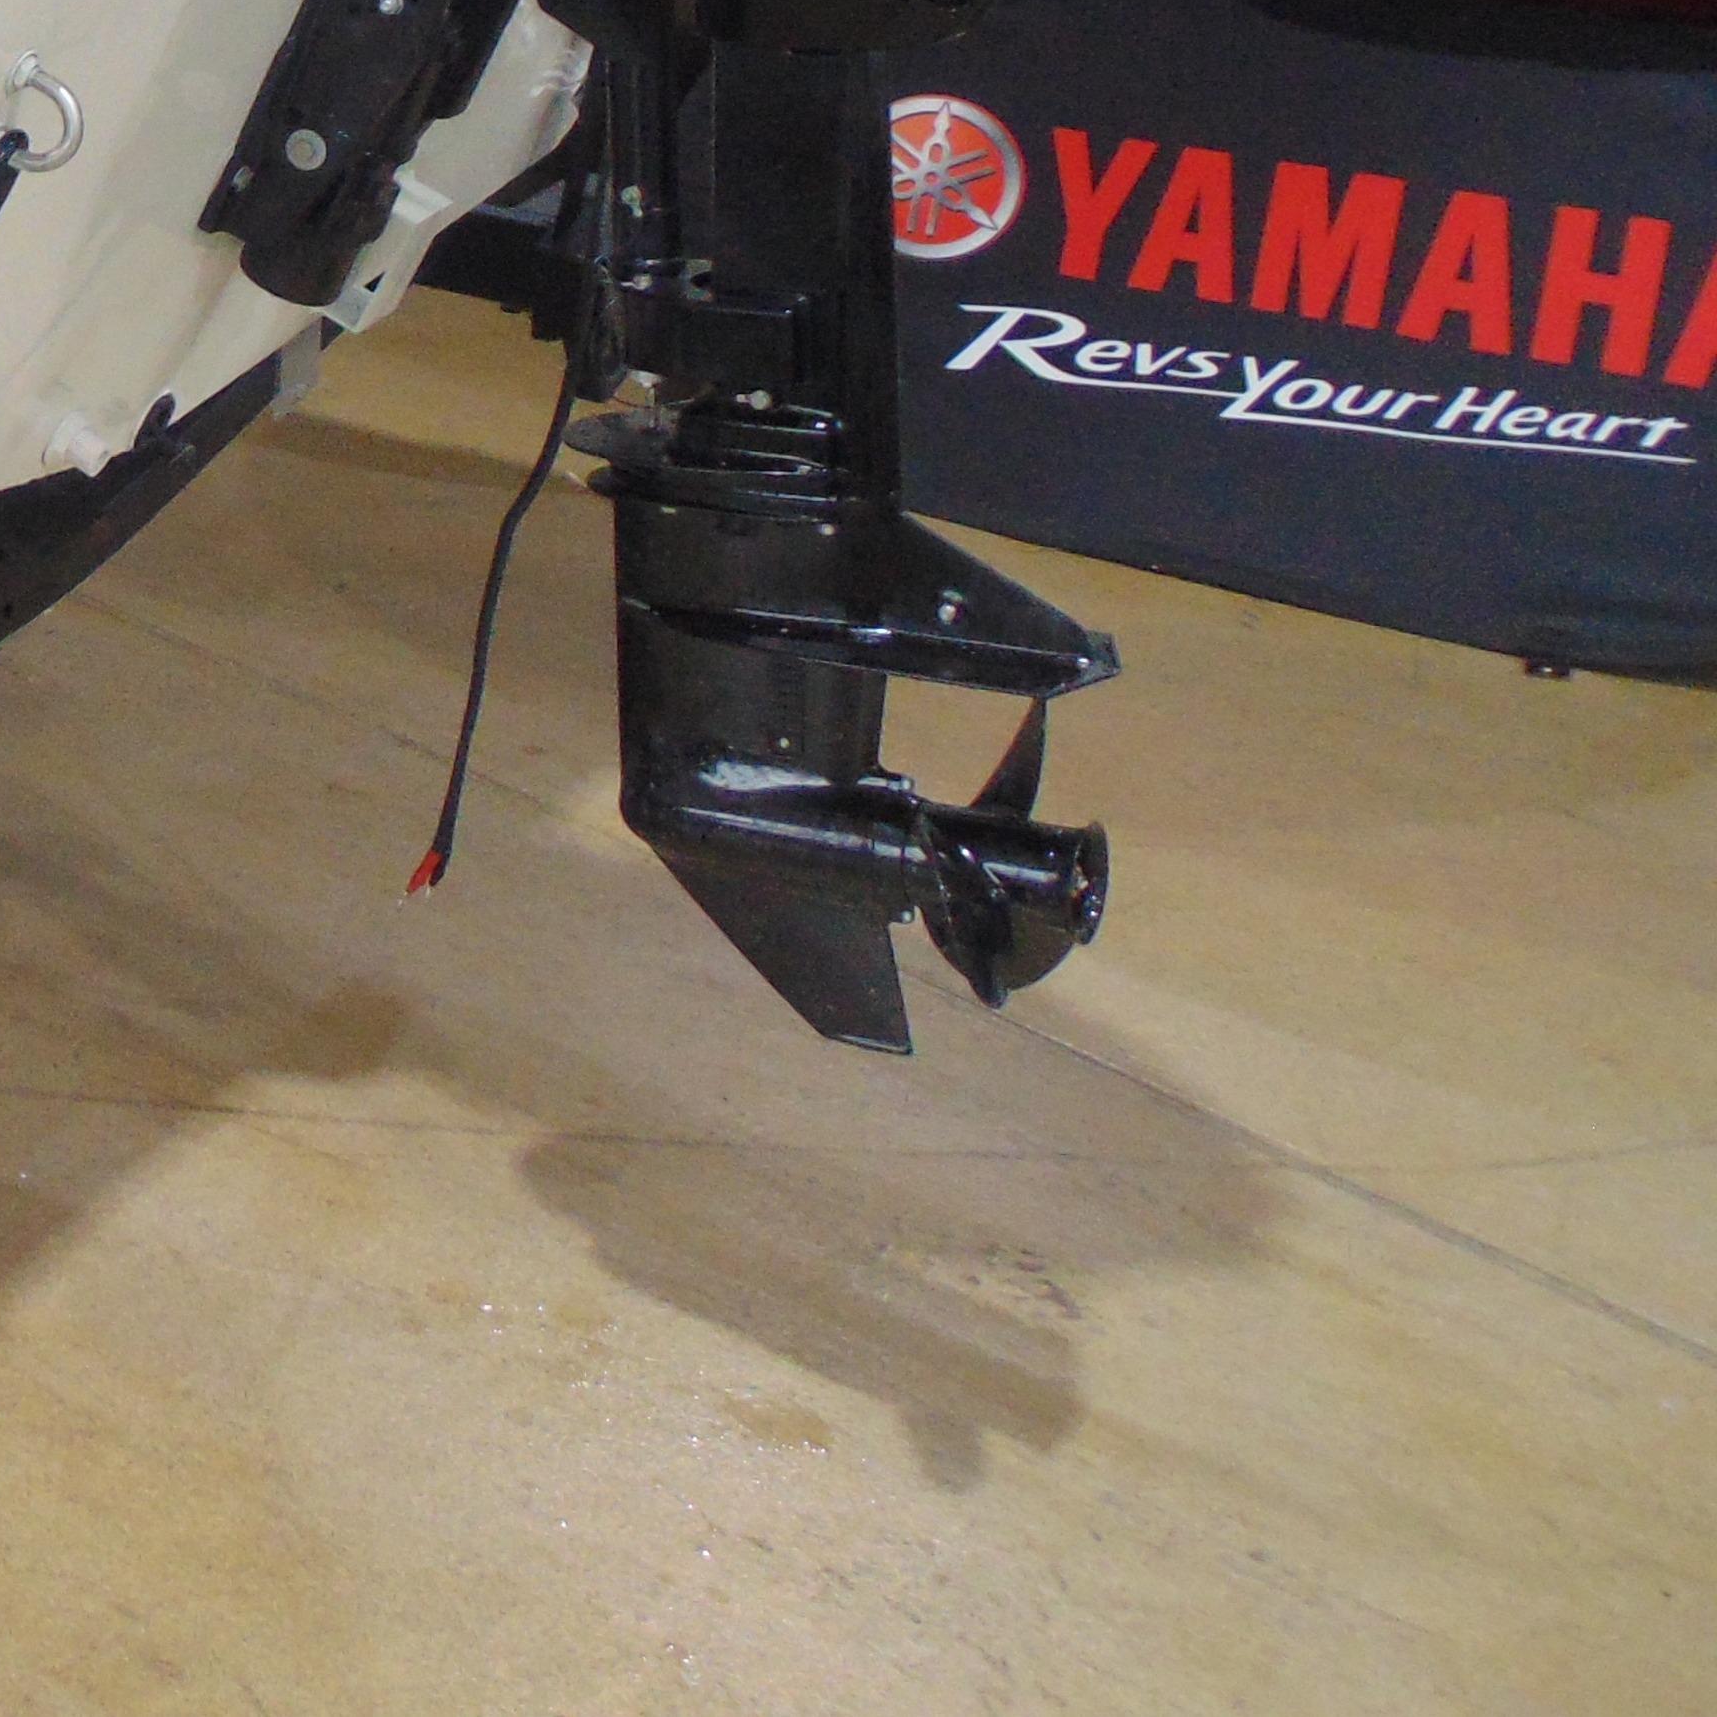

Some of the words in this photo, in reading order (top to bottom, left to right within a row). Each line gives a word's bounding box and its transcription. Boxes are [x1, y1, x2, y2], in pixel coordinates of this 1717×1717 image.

[945, 304, 1237, 394] Revs
[1220, 356, 1442, 422] Your
[1434, 386, 1691, 450] Heart
